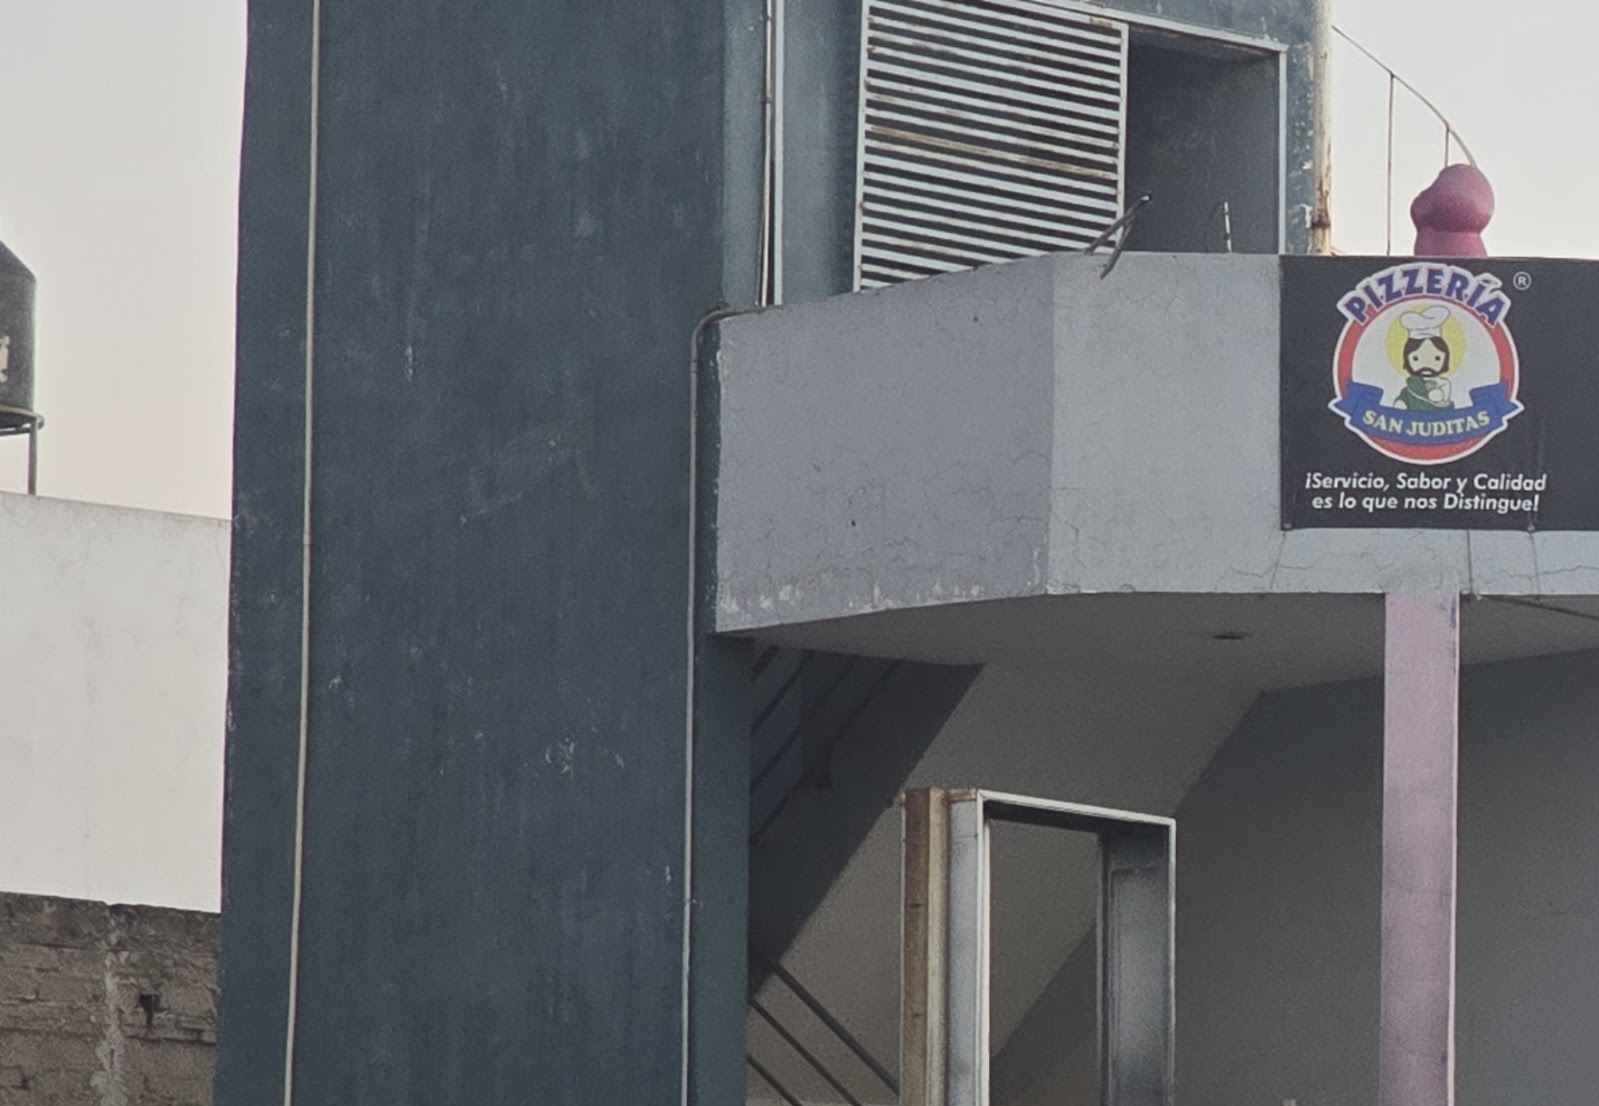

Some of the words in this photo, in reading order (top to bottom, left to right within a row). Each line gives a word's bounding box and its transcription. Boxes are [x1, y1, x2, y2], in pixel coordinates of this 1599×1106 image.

[1344, 267, 1506, 326] PIZZERÍA
[1362, 409, 1403, 433] SAN
[1405, 410, 1491, 437] JUDITAS
[1305, 472, 1390, 492] ¡Servicio,
[1396, 473, 1451, 490] Sabor
[1456, 476, 1467, 494] y
[1473, 473, 1548, 491] Calidad
[1312, 497, 1333, 509] es
[1339, 492, 1357, 509] lo
[1362, 496, 1398, 512] que
[1404, 497, 1438, 510] nos
[1443, 494, 1540, 514] Distingue!
